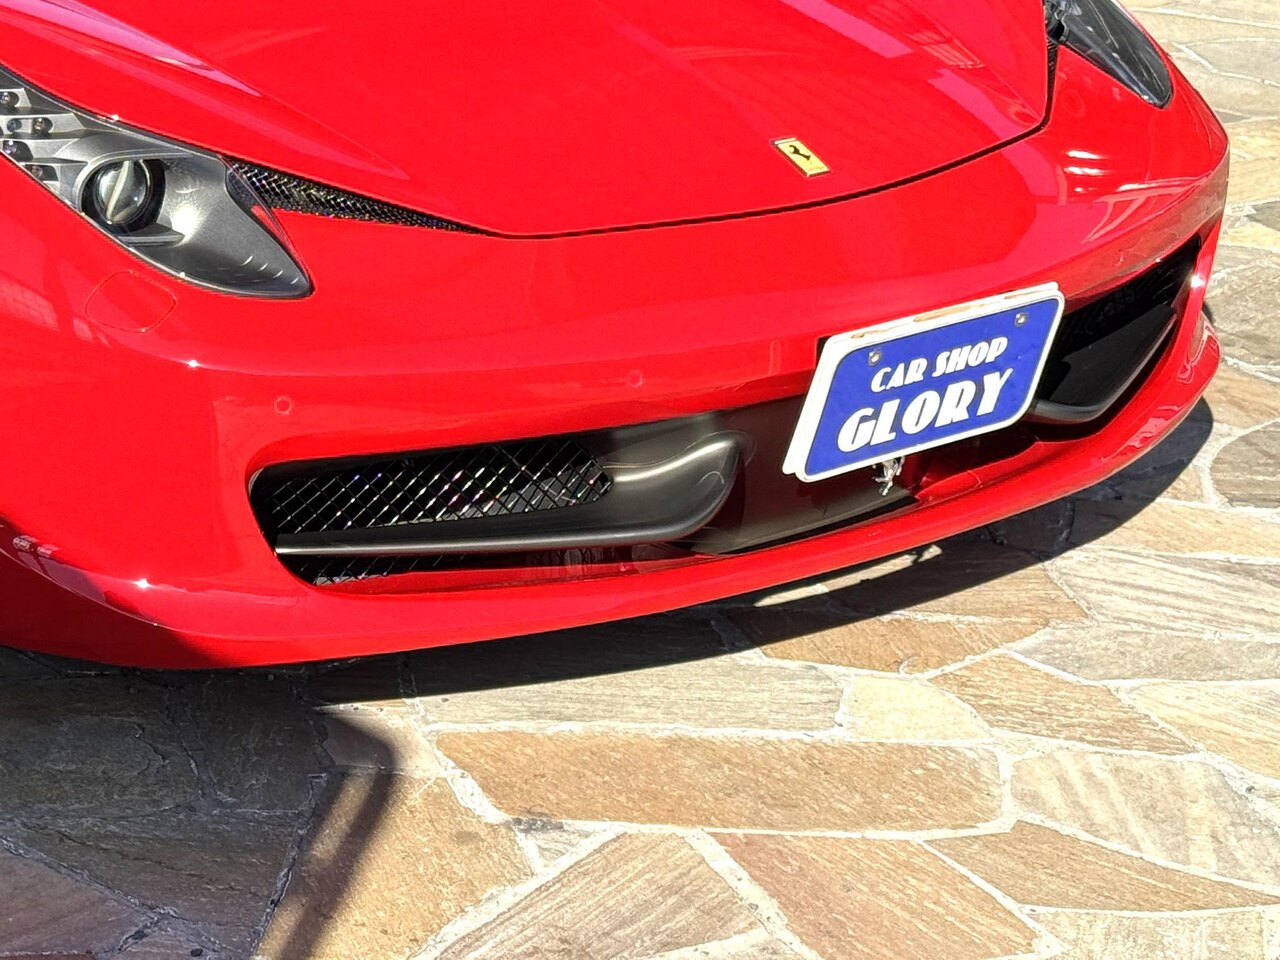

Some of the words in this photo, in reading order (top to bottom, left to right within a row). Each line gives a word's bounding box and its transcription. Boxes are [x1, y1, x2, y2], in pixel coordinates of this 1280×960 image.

[871, 357, 928, 393] CAR
[931, 336, 1009, 378] SHOP
[837, 367, 1014, 453] GLORY
